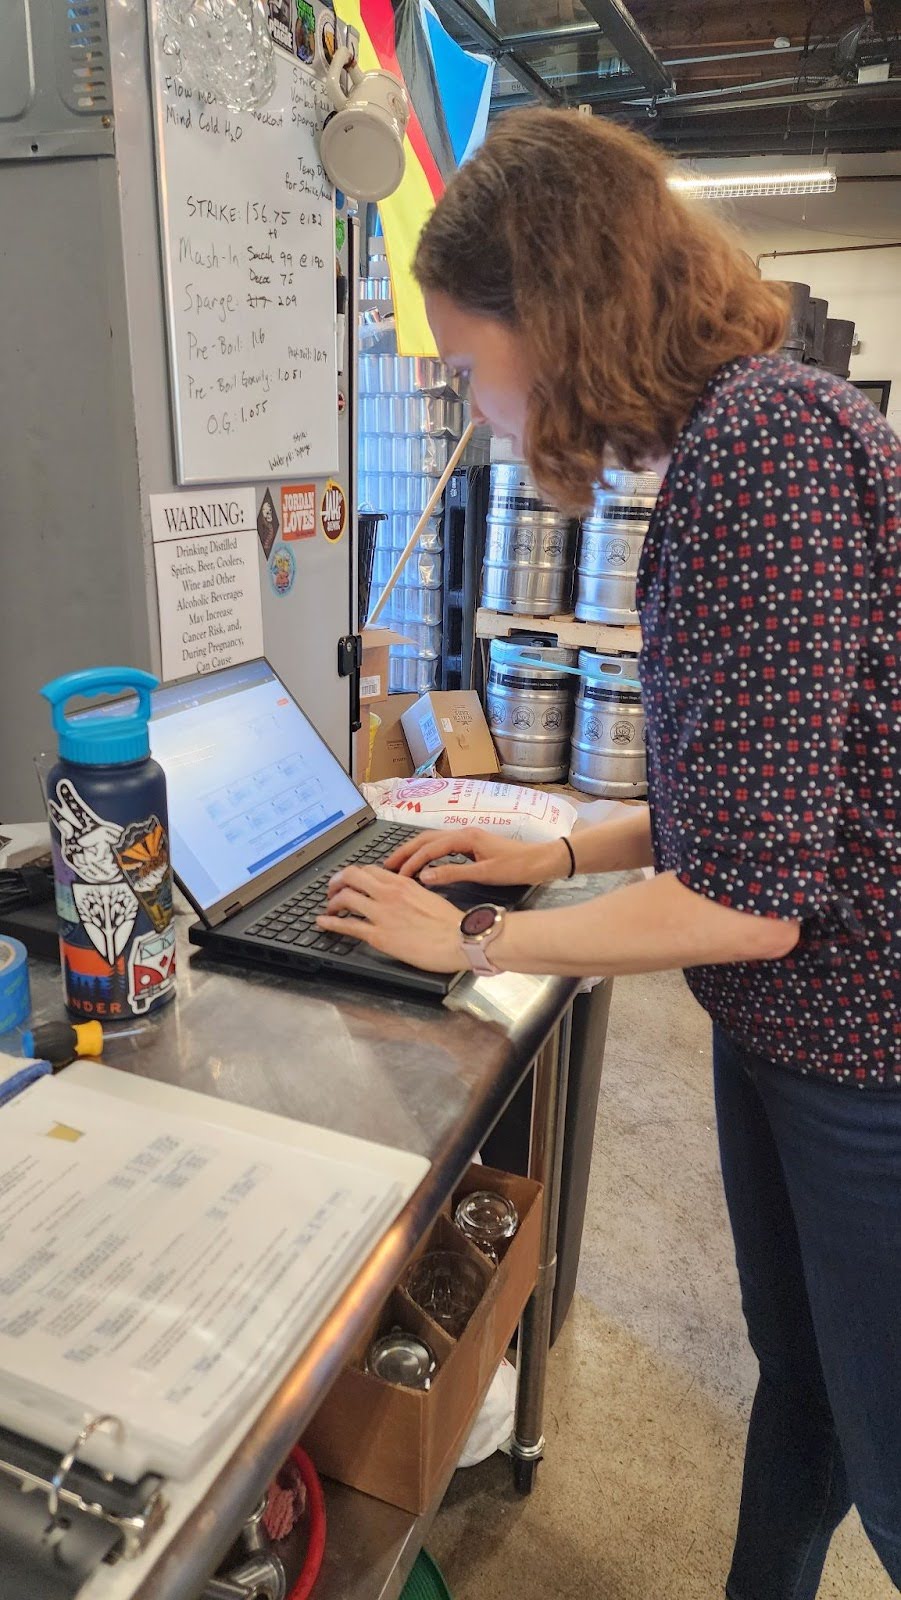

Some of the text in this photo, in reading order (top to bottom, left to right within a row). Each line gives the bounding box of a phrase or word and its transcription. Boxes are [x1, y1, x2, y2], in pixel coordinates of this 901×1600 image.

[165, 76, 193, 98] Flow
[166, 105, 192, 128] Mind
[199, 113, 220, 135] Cold
[285, 171, 297, 191] for
[187, 196, 241, 224] STRIKE:
[278, 367, 302, 382] 1.051
[240, 399, 268, 423] 1.055
[282, 491, 315, 512] JORDAN
[164, 501, 245, 533] WARNING:
[283, 510, 315, 533] LOVES
[176, 538, 238, 558] Drinking Distilled
[171, 555, 245, 578] Spirits, Beer, Coolers,
[182, 573, 236, 592] Wine and Other
[176, 590, 244, 612] Alcoholic Beverages
[189, 607, 233, 626] May Increase
[182, 620, 242, 644] Cancer Risk, and,
[182, 638, 244, 661] During Pregnancy,
[196, 656, 232, 674] Can Cause
[444, 815, 469, 826] 25kg
[478, 816, 491, 825] 55
[492, 816, 512, 826] Lbs
